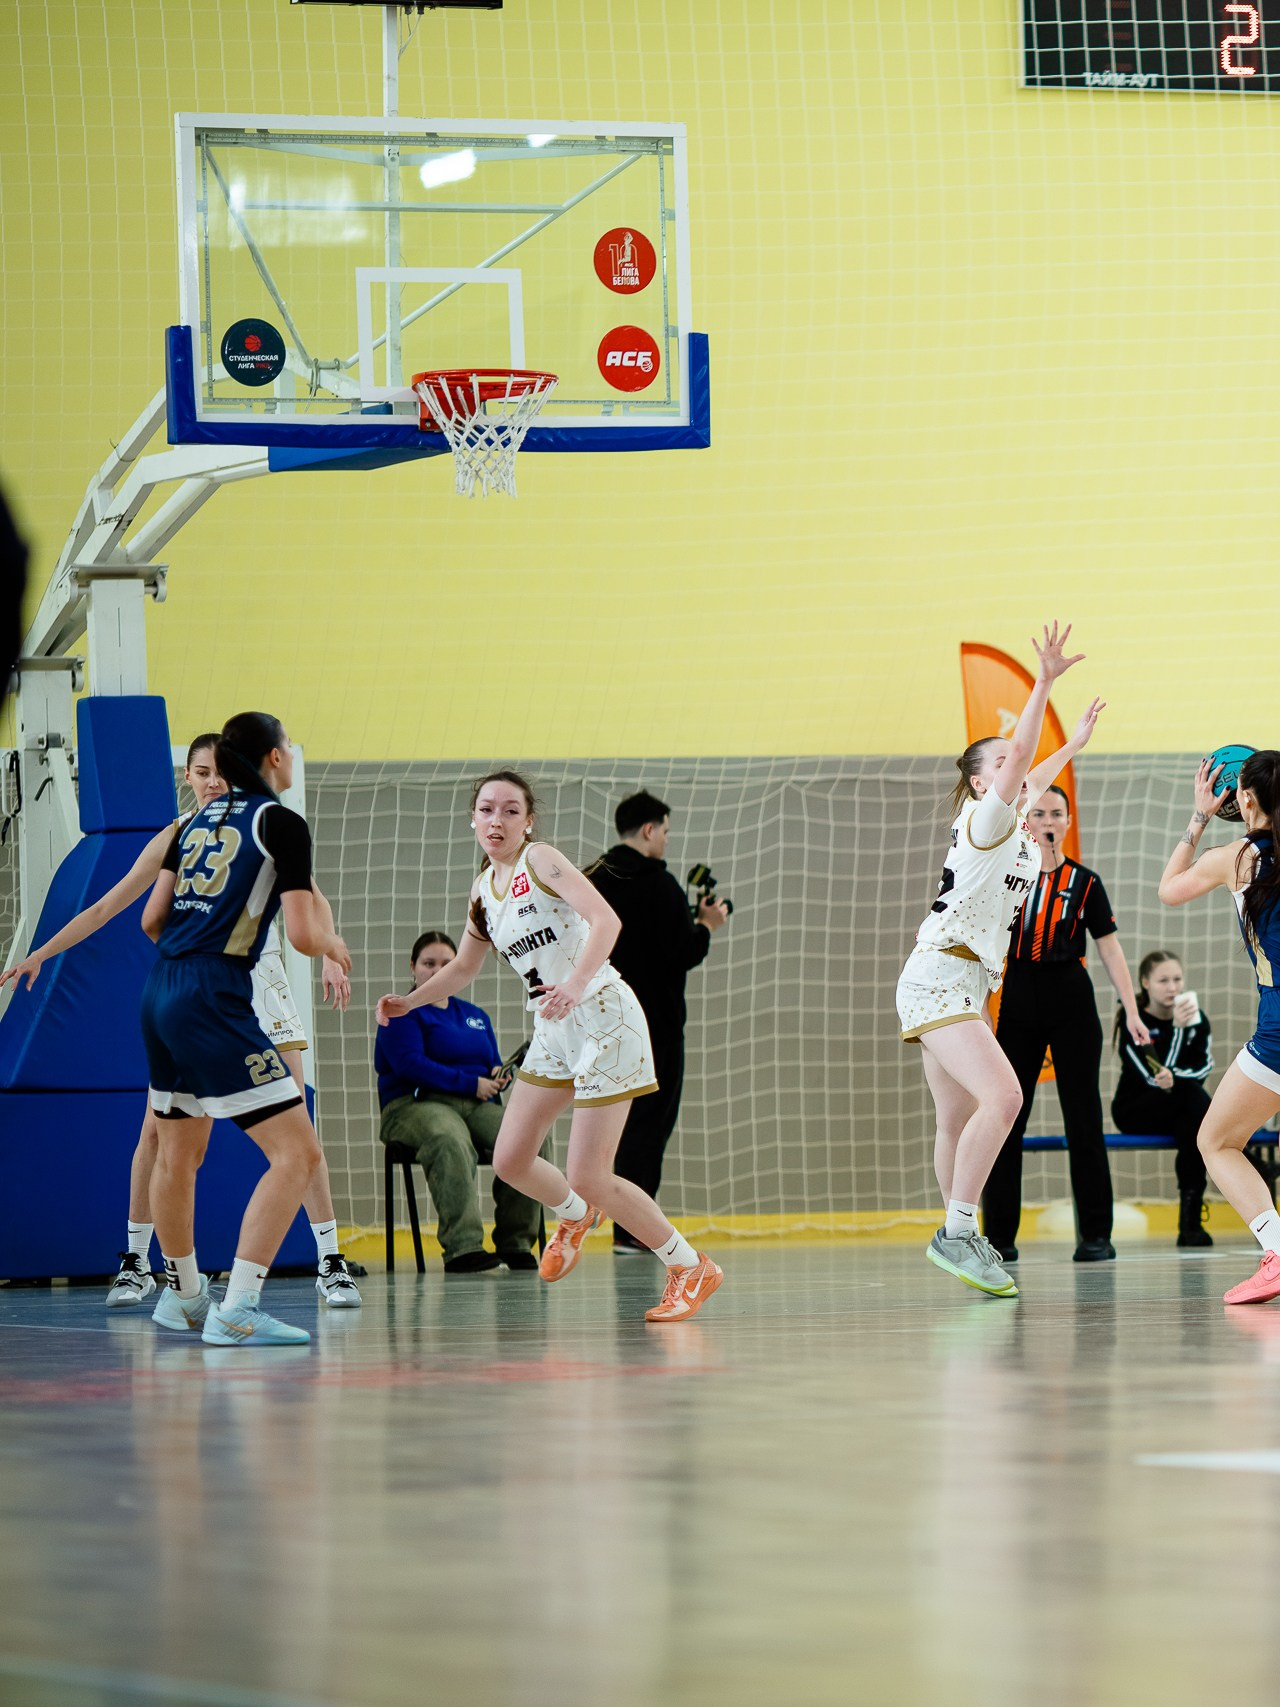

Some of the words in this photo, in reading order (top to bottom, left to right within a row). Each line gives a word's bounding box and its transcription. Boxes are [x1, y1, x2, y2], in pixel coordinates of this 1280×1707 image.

[1220, 4, 1259, 76] 2
[621, 267, 639, 277] ЛИГА
[612, 276, 640, 286] БЕЛОВА
[228, 354, 279, 362] СТУДЕНЧЕСКАЯ
[605, 351, 653, 368] АСБ
[174, 826, 242, 897] 23
[244, 1048, 286, 1086] 23
